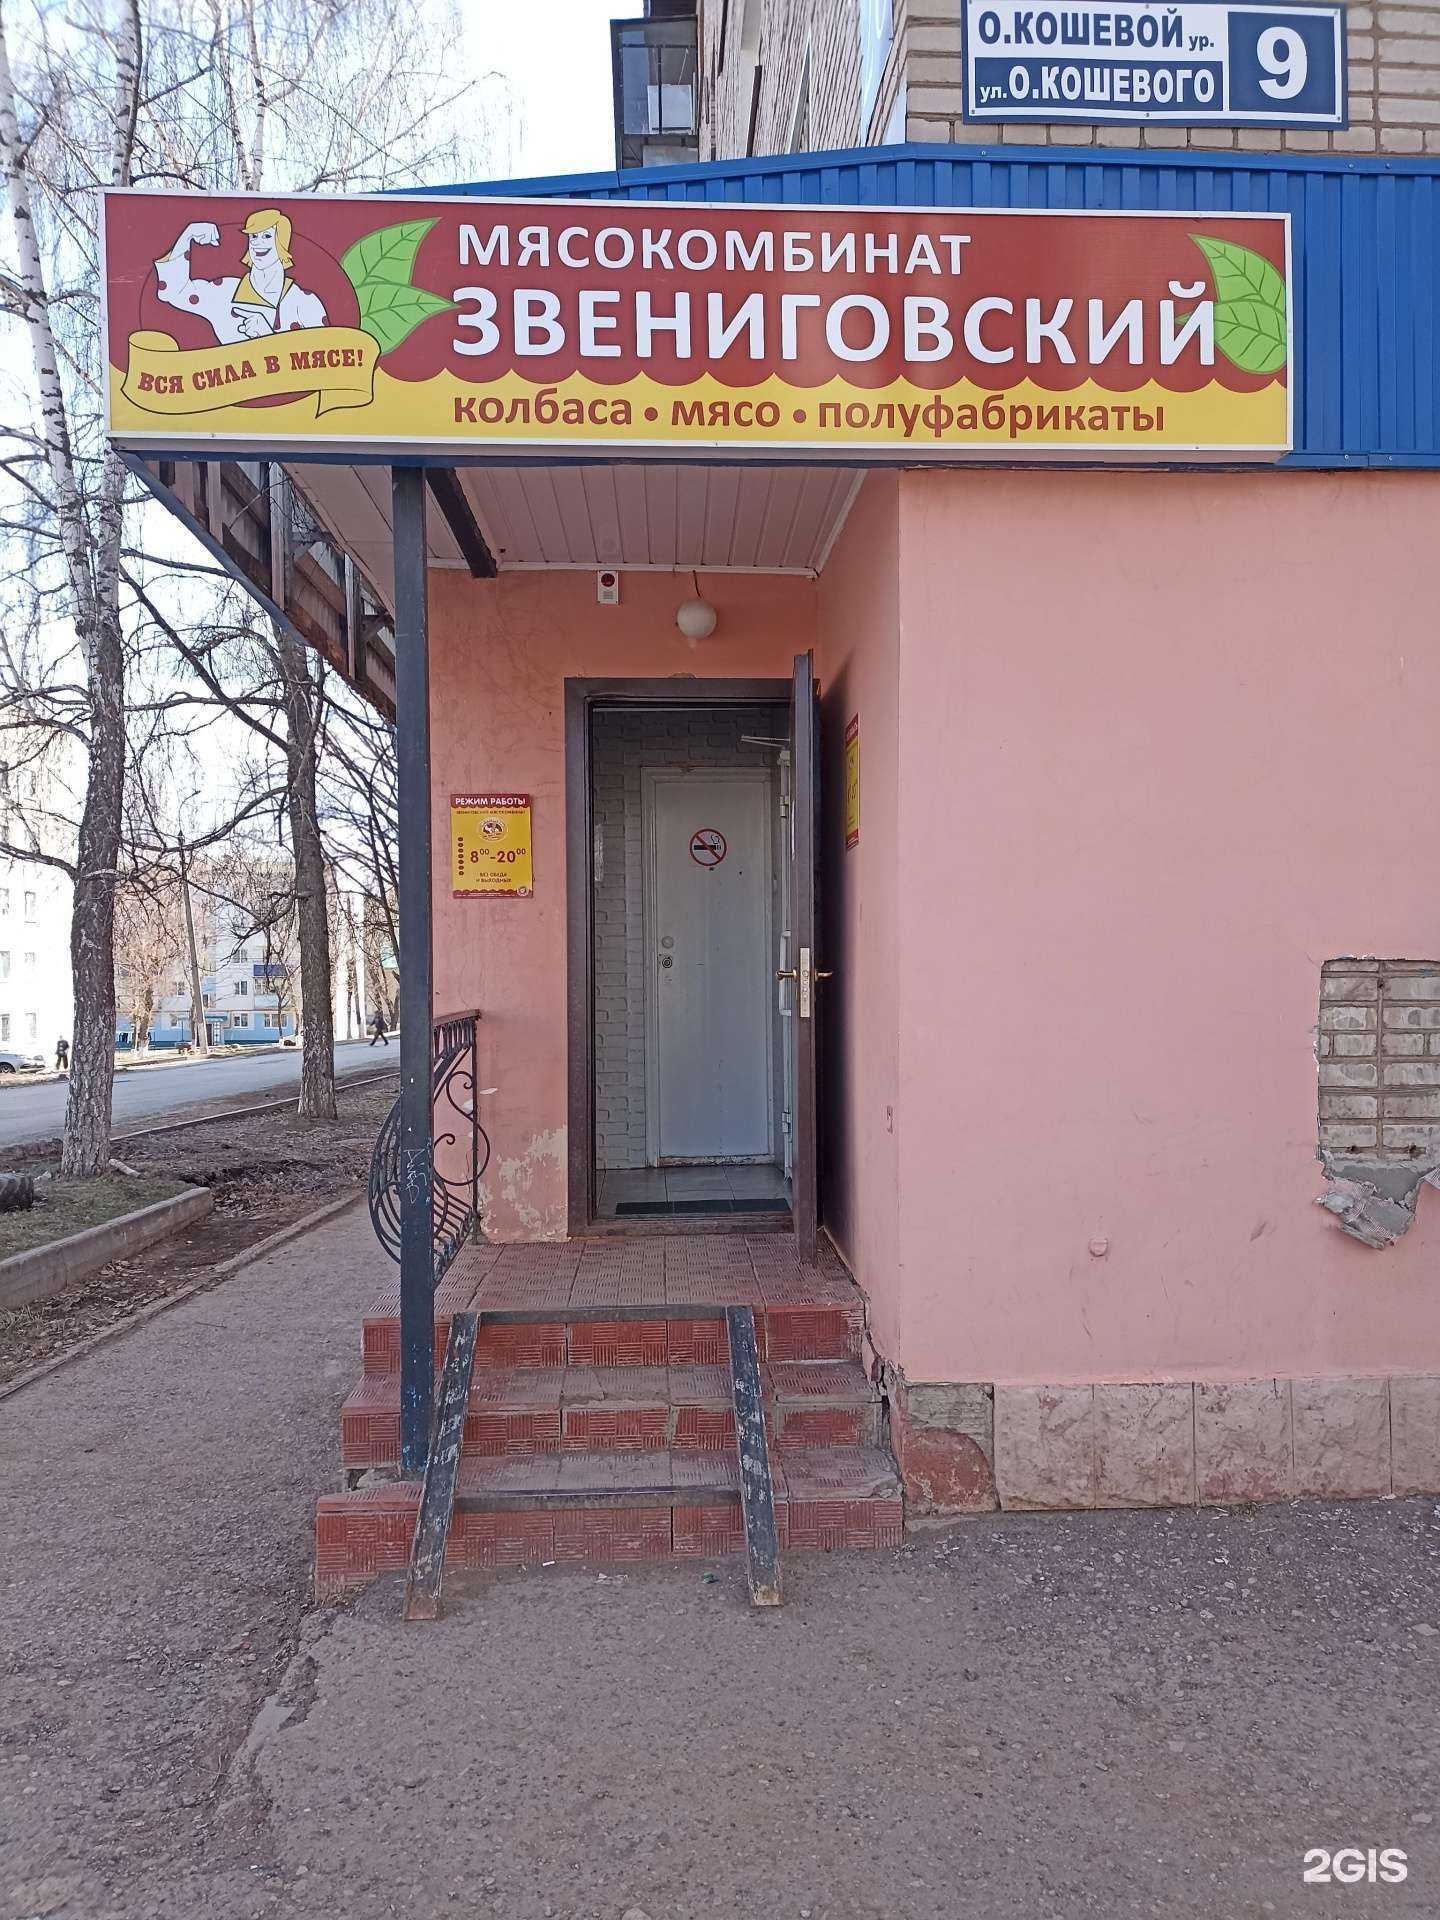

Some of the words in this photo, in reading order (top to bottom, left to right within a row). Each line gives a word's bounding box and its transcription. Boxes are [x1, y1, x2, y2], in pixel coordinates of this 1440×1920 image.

[977, 9, 1183, 49] О.КОШЕВОЙ
[1188, 32, 1215, 52] ур.
[1256, 25, 1309, 100] 9
[458, 223, 972, 276] МЯСОКОМБИНАТ
[451, 280, 1216, 366] ЗВЕНИГОВСКИЙ
[137, 371, 185, 394] ВСЯ
[192, 359, 257, 391] СИЛА
[263, 354, 281, 375] В
[289, 348, 365, 371] МЯСЕ!
[453, 387, 633, 425] колбаса
[670, 399, 781, 428] мясо
[818, 394, 1165, 438] полуфабрикаты
[455, 797, 488, 805] РЕЖИМ
[490, 797, 526, 805] РАБОТЫ
